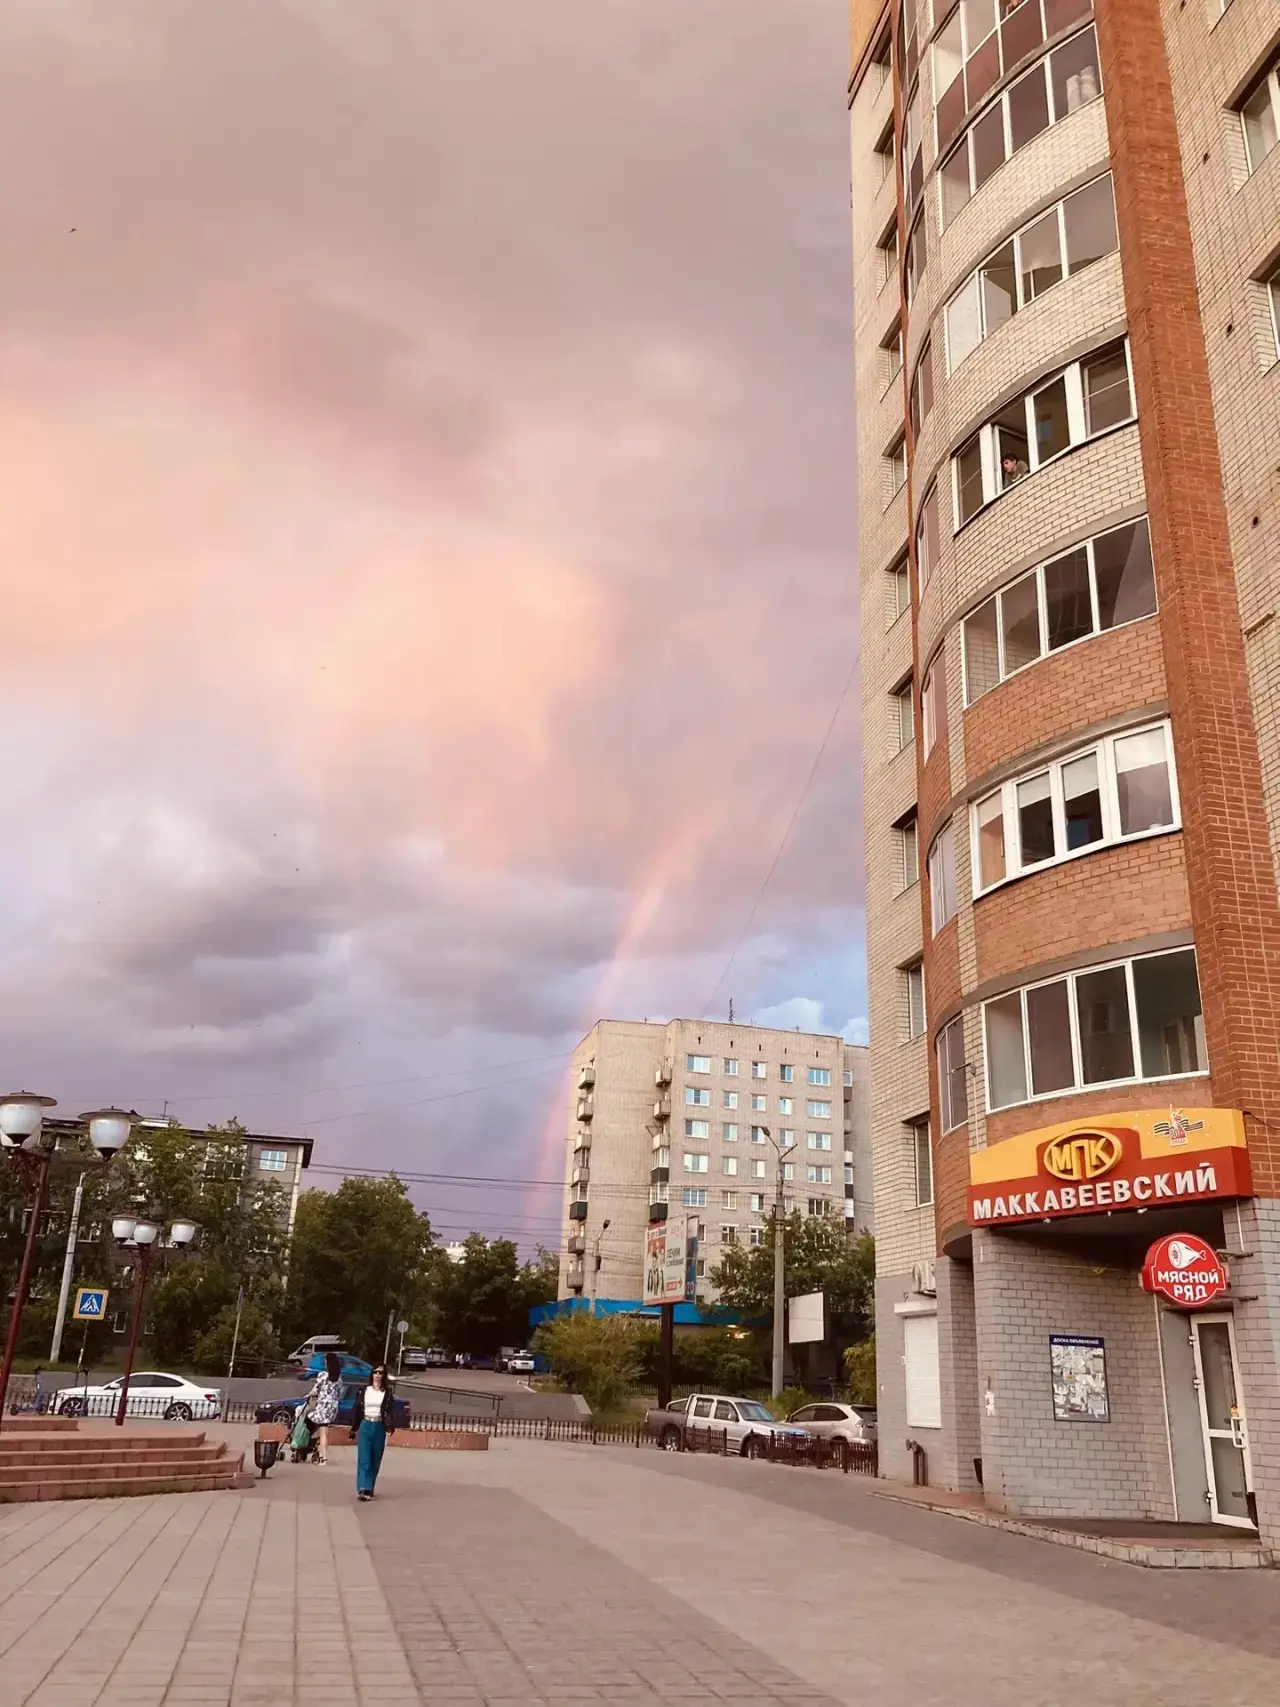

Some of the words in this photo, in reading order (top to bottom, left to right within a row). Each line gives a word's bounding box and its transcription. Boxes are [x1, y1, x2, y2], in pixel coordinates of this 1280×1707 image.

[1050, 1137, 1110, 1180] МПК
[973, 1162, 1217, 1220] МАККАВЕЕВСКИЙ
[1157, 1268, 1219, 1284] МЯСНОЙ
[1173, 1284, 1208, 1301] РЯД
